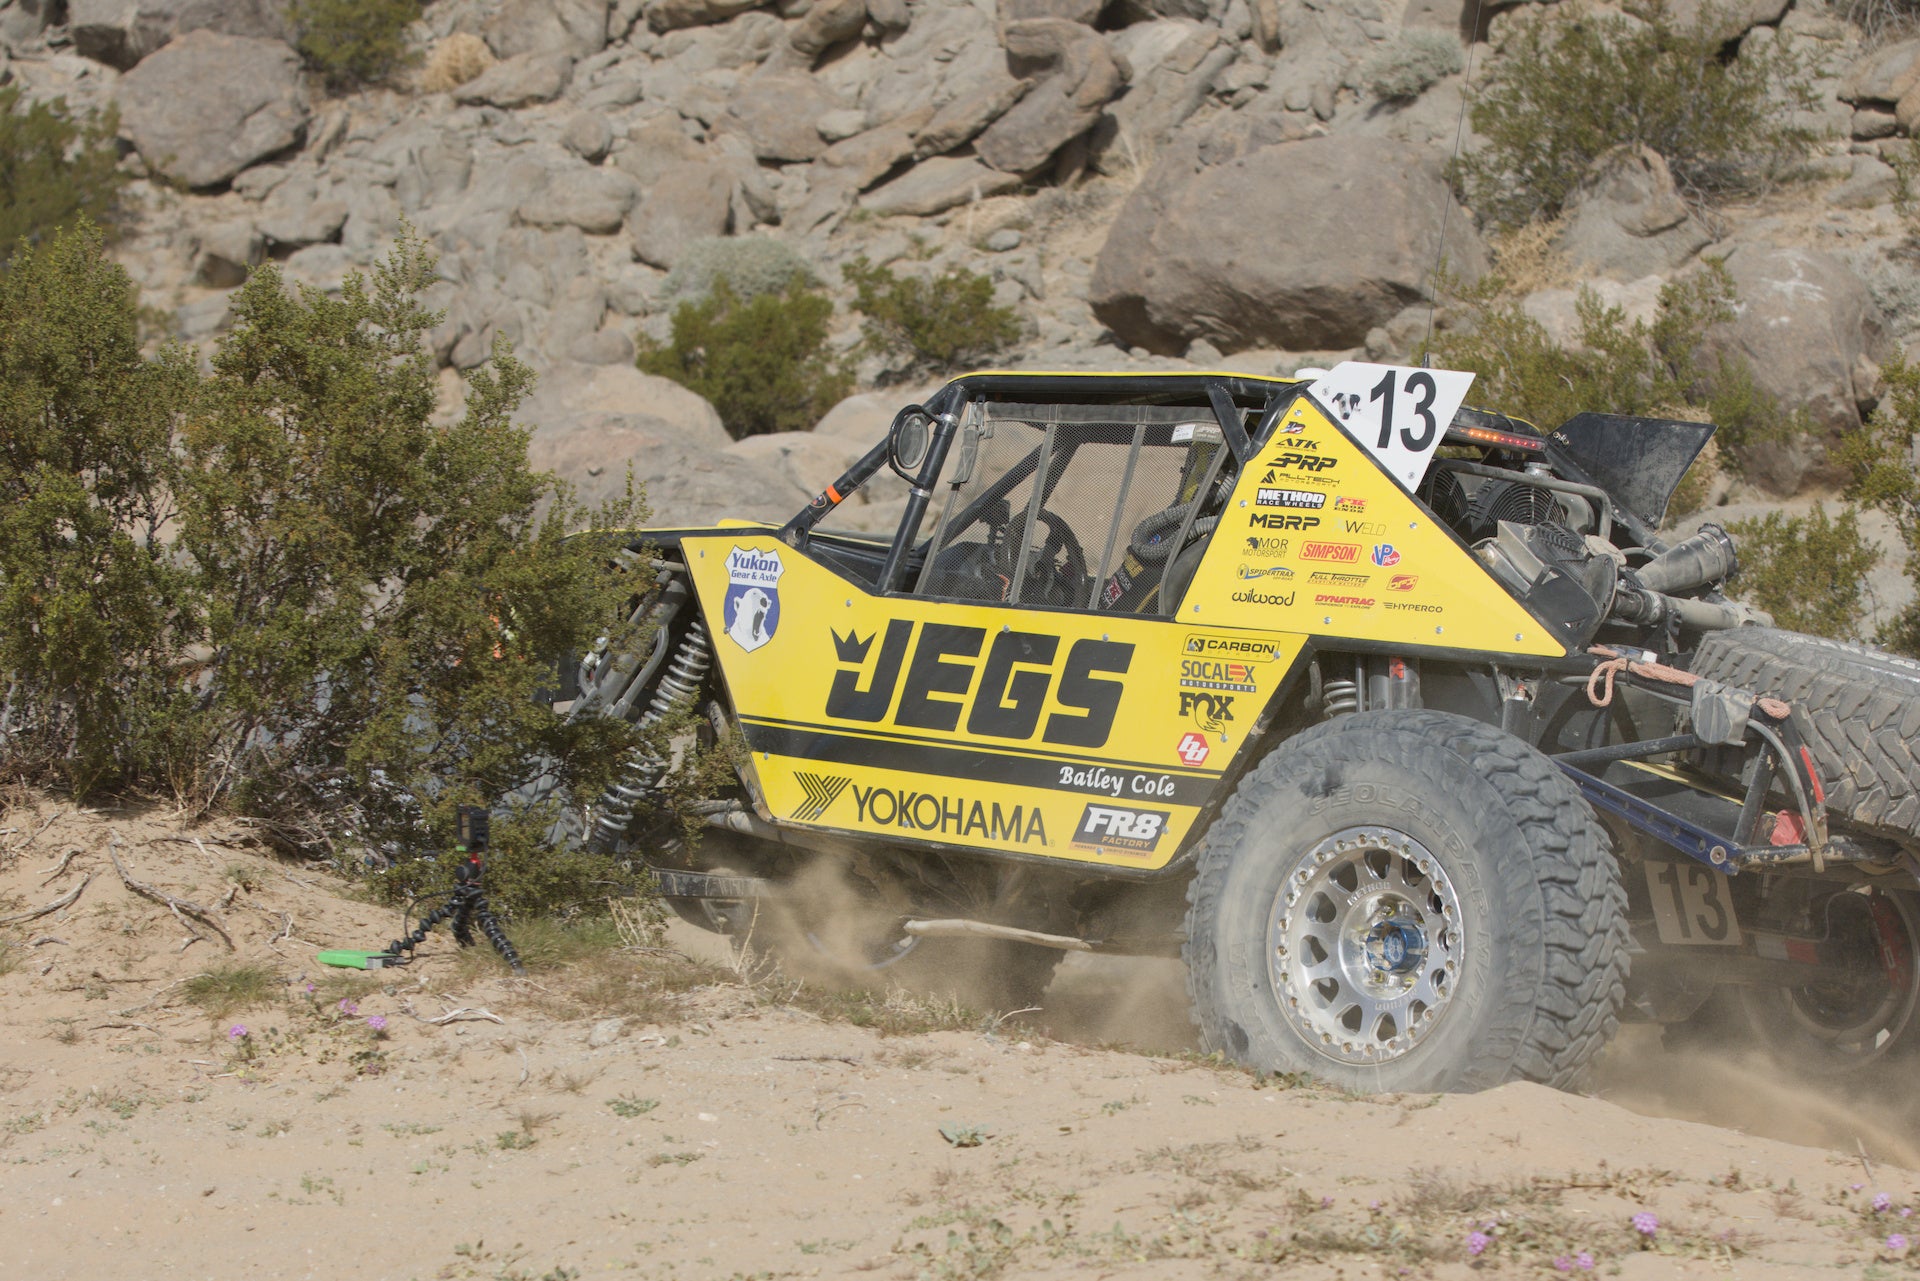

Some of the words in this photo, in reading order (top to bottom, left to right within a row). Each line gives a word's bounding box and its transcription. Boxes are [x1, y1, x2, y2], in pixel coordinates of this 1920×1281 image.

[1370, 370, 1437, 453] 13
[1276, 438, 1321, 450] ATK
[1266, 452, 1338, 472] PRP
[1258, 488, 1325, 504] METHOD
[1249, 513, 1321, 531] MBRP
[1345, 520, 1387, 537] WELD
[1258, 537, 1289, 550] MOR
[1303, 543, 1357, 561] SIMPSON
[732, 552, 779, 573] Yukon
[1374, 544, 1394, 567] VP
[731, 569, 750, 579] Gear
[751, 571, 757, 580] &
[758, 572, 777, 583] Axle
[1249, 568, 1296, 578] SPIDERTRAX
[1310, 571, 1329, 581] FULL
[1232, 588, 1296, 607] wilwood
[1314, 594, 1376, 607] DYNATRAC
[1393, 602, 1443, 613] HYPERCO
[1207, 640, 1275, 654] CARBON
[825, 618, 1136, 749] JEGS
[1181, 680, 1256, 693] MOTORSPORTS
[1178, 692, 1235, 722] FOX
[1059, 766, 1124, 797] Bailey
[1131, 774, 1175, 797] Cole
[852, 783, 1049, 848] YOKOHAMA
[1083, 806, 1163, 840] FR8
[1101, 836, 1151, 848] FACTORY
[1658, 863, 1729, 941] 13
